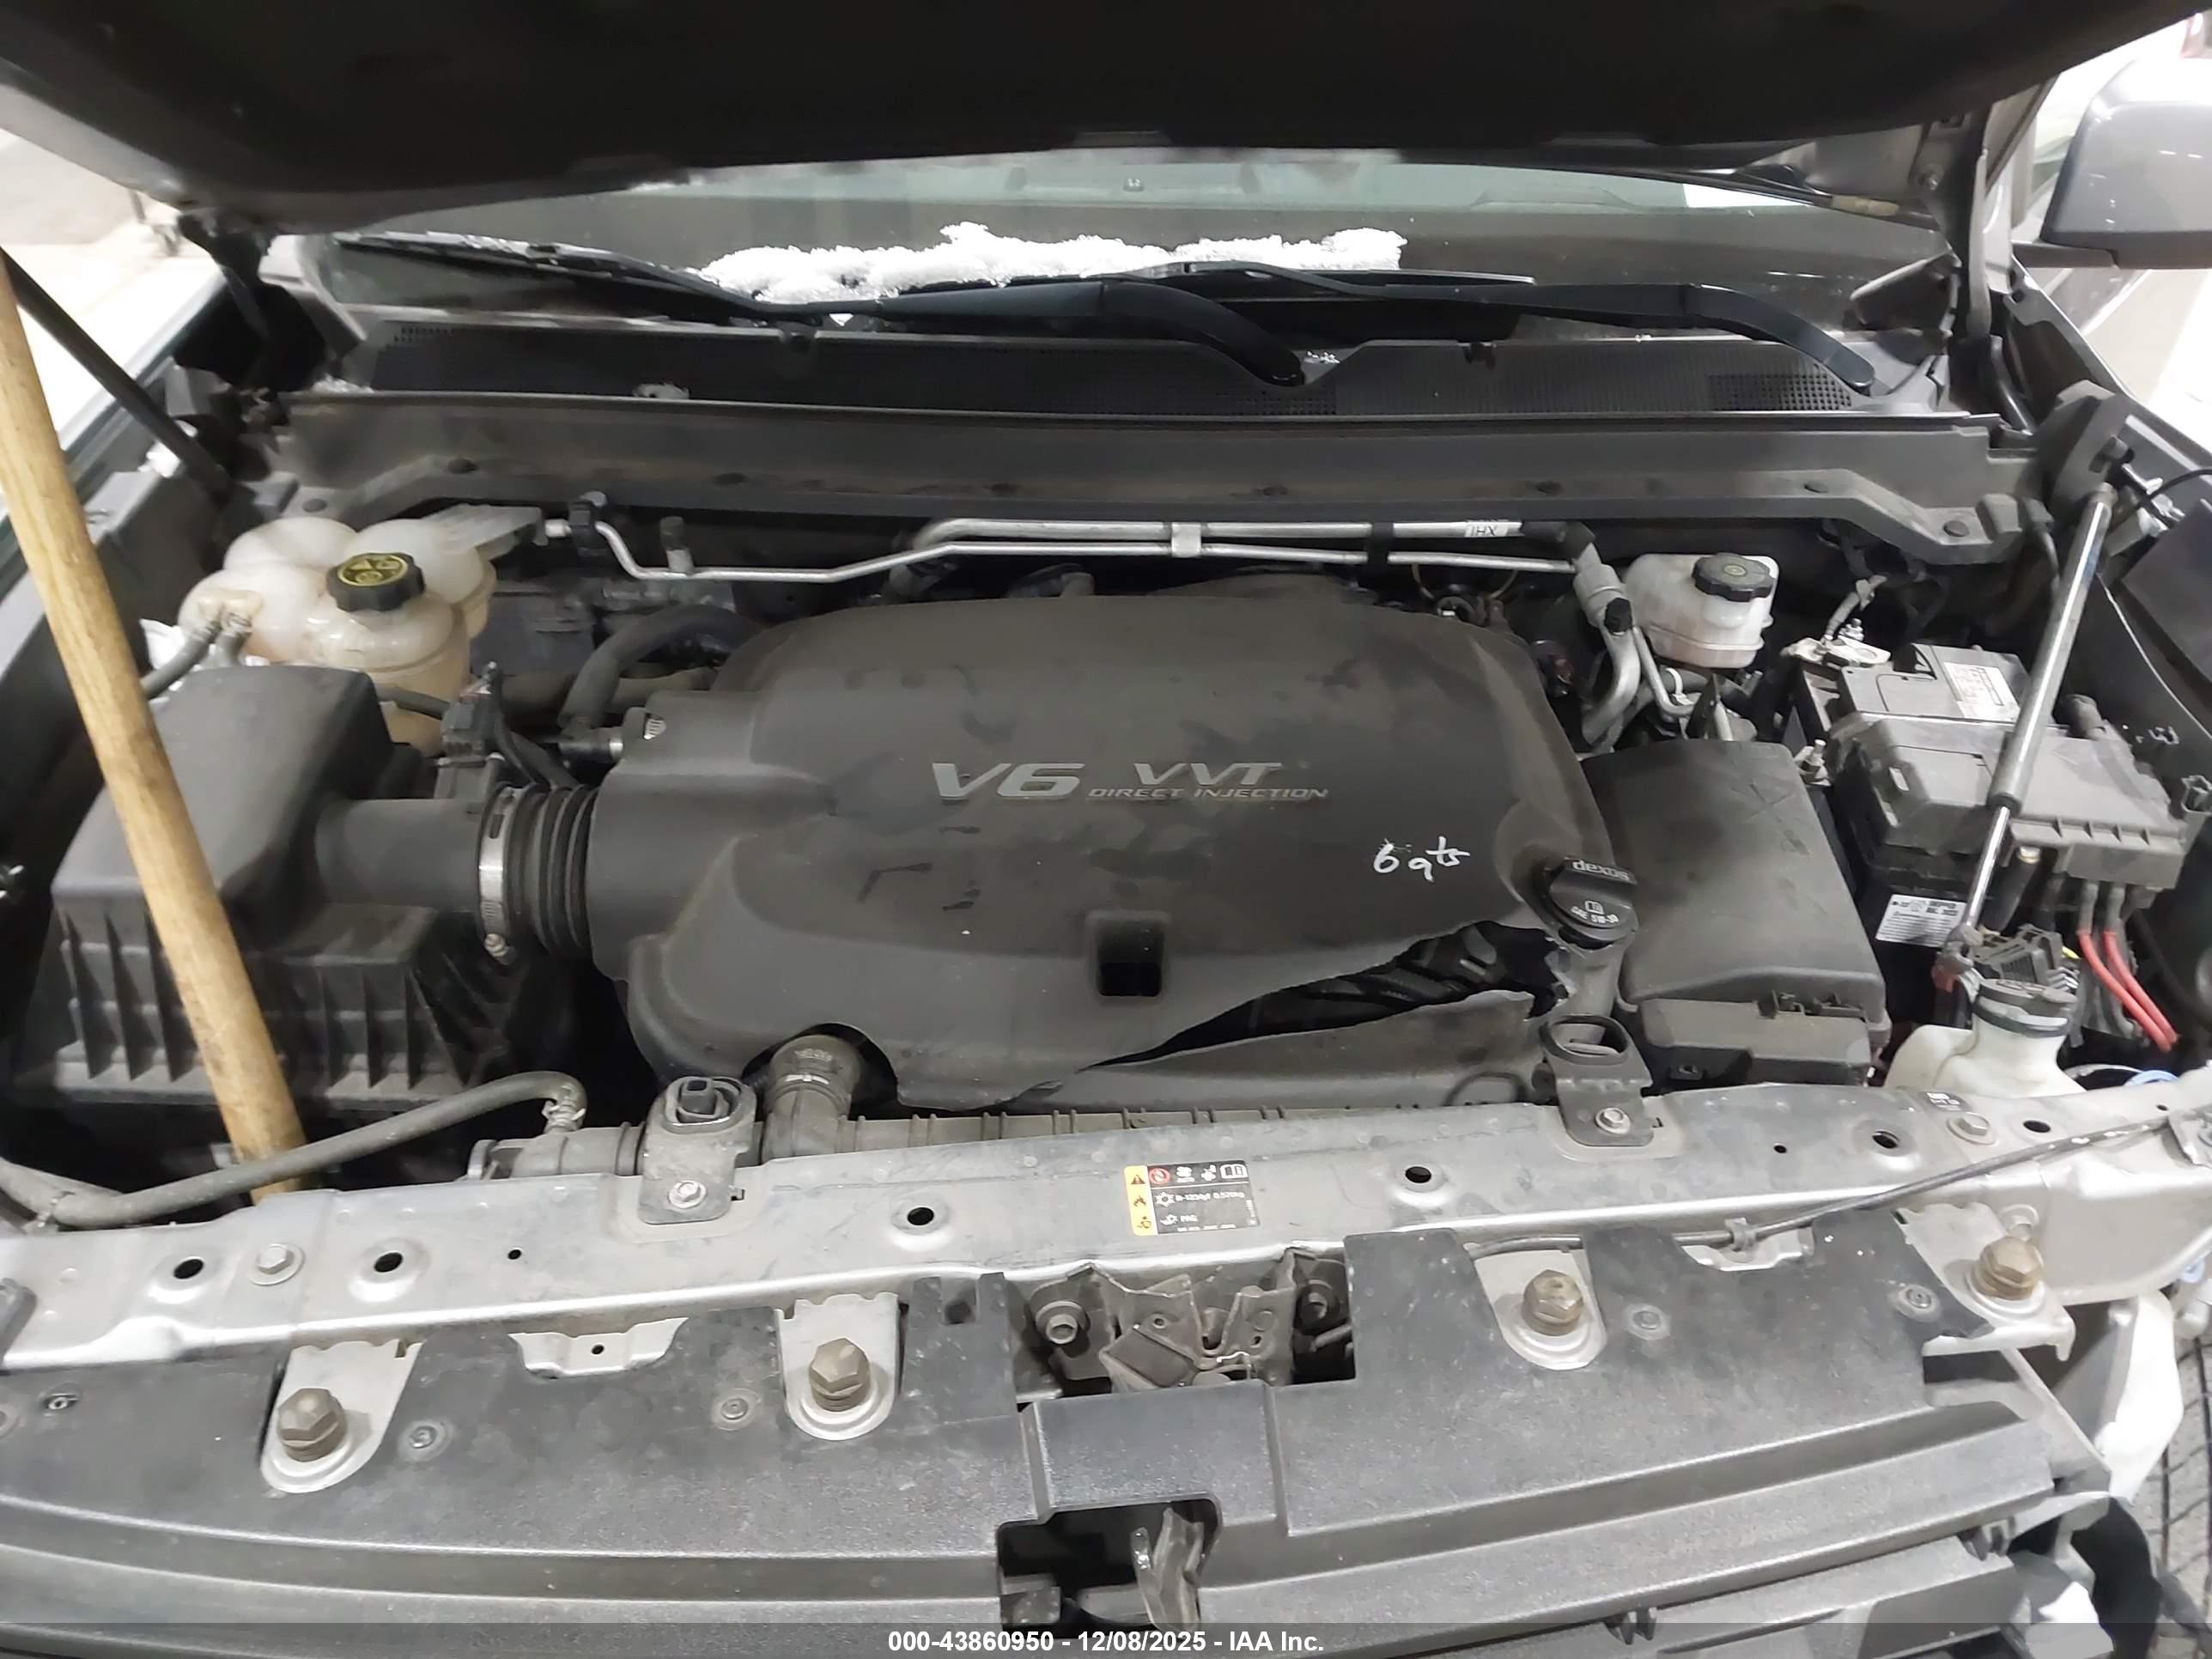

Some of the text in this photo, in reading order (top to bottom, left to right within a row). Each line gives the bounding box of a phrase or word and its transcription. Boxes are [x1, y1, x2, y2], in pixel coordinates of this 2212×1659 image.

[932, 763, 1085, 799] V6
[1133, 762, 1283, 786] VVT
[1088, 787, 1329, 799] DIRECT INJECTION
[1373, 838, 1400, 873] 6
[1572, 860, 1629, 880] dexos
